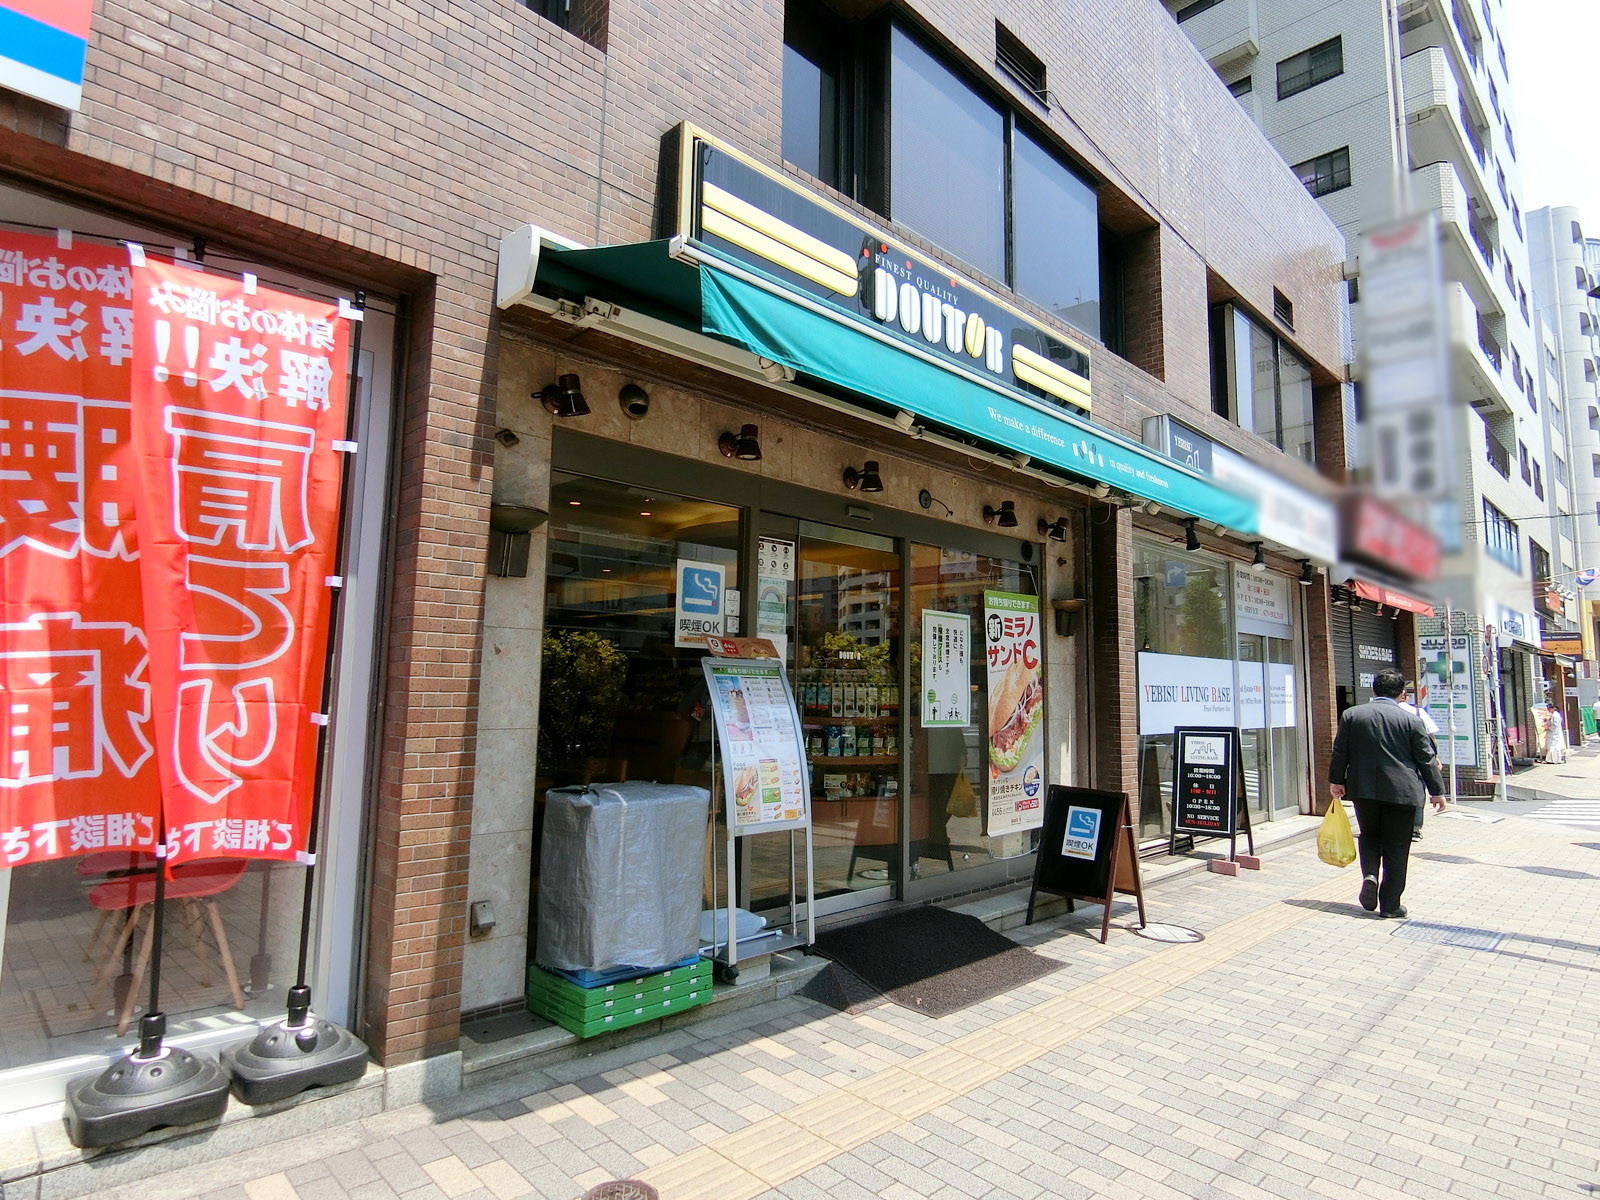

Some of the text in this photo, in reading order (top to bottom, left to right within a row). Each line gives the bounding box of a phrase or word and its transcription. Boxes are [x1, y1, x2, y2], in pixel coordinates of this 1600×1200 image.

[875, 254, 959, 305] FINEST QUALITY
[874, 268, 1003, 374] DOUTOR
[988, 407, 1169, 489] We make a difference in quality and freshness
[680, 618, 720, 634] 喫煙OK
[988, 616, 1034, 640] 新 ミラノ
[988, 639, 1039, 670] サンドC
[1144, 685, 1231, 703] YEBISU LIVING BASE
